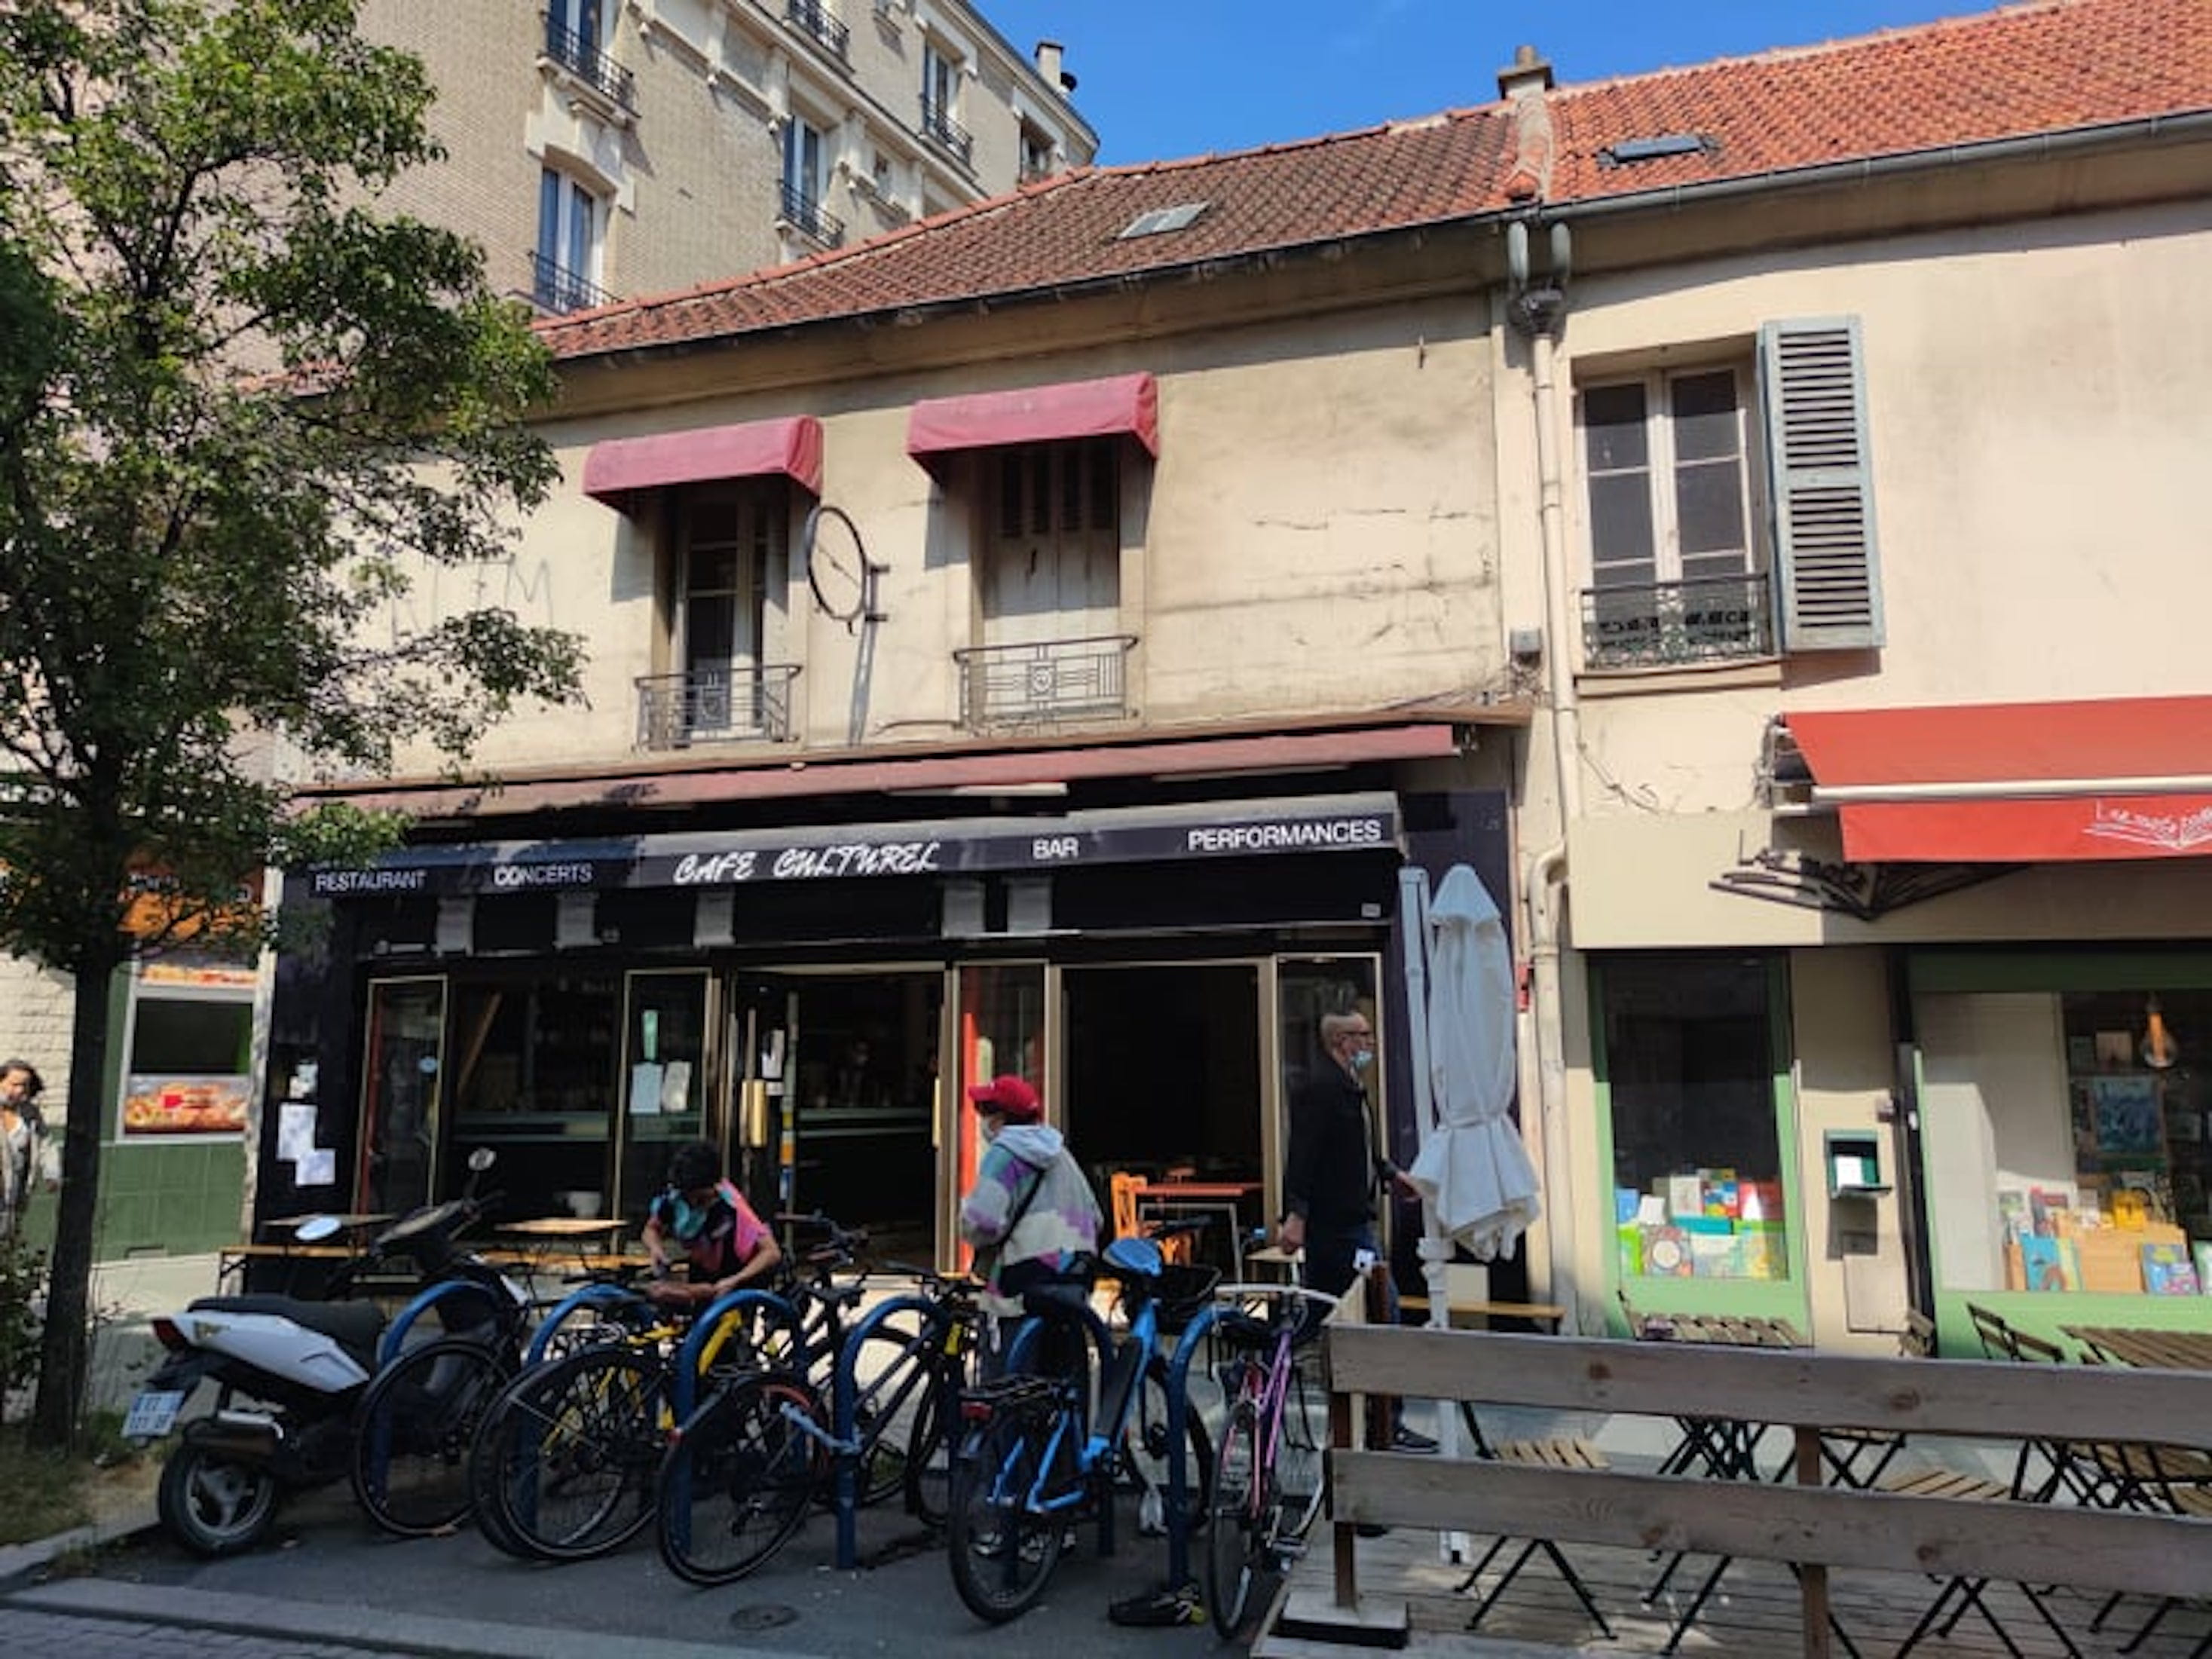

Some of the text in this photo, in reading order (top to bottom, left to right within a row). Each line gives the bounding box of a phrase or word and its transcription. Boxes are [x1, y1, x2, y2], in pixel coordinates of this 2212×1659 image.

[314, 819, 1381, 892] RESTAURANT CONCERTS CAFE CULTUREL BAR PERFORMANCES
